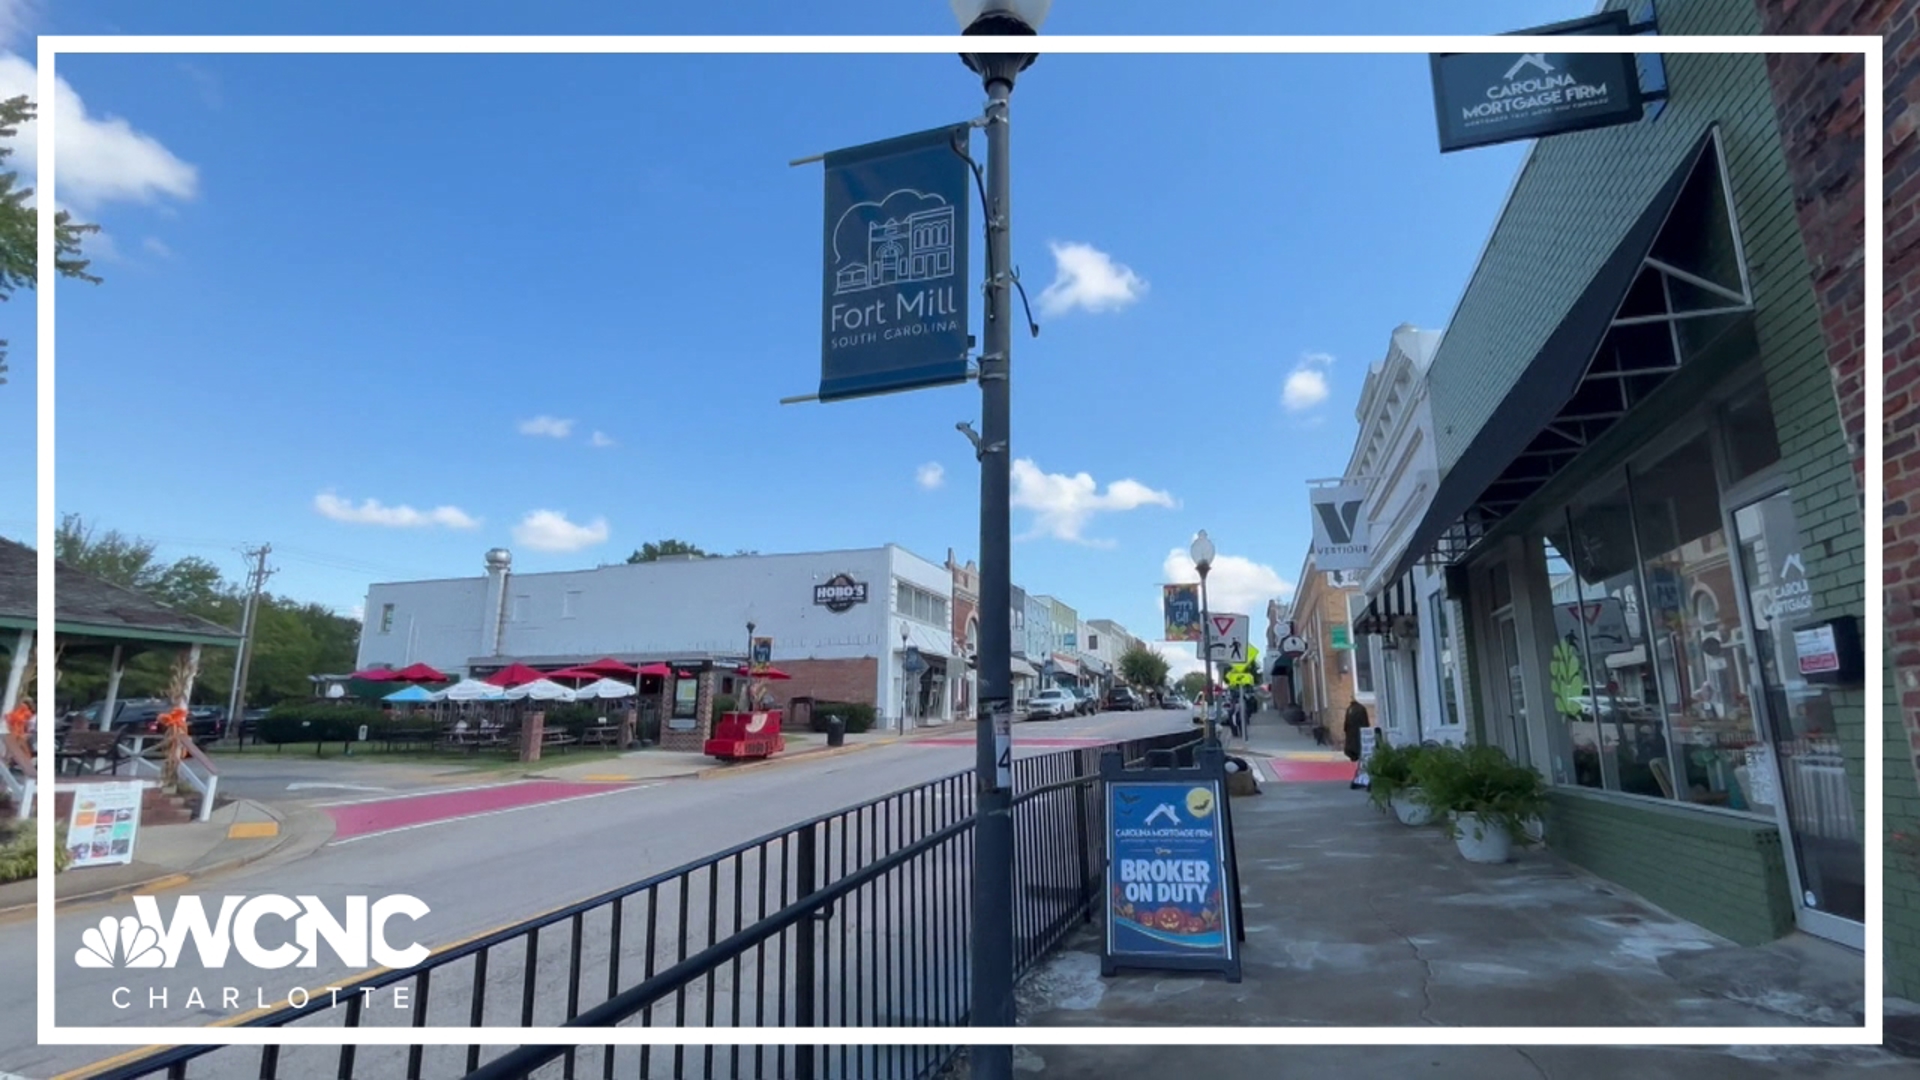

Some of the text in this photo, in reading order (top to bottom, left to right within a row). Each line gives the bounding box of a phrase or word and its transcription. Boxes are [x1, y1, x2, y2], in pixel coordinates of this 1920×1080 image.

[1486, 73, 1576, 100] CAROLINA
[1461, 82, 1607, 120] MORTGAGE FIRM
[831, 286, 957, 332] Fort Mill
[831, 320, 958, 349] SOUTH CAROLINA
[1317, 545, 1368, 556] VESTIQUE
[817, 584, 864, 598] HOBO'S
[1120, 859, 1211, 883] BROKER
[1125, 883, 1209, 903] ON DUTY
